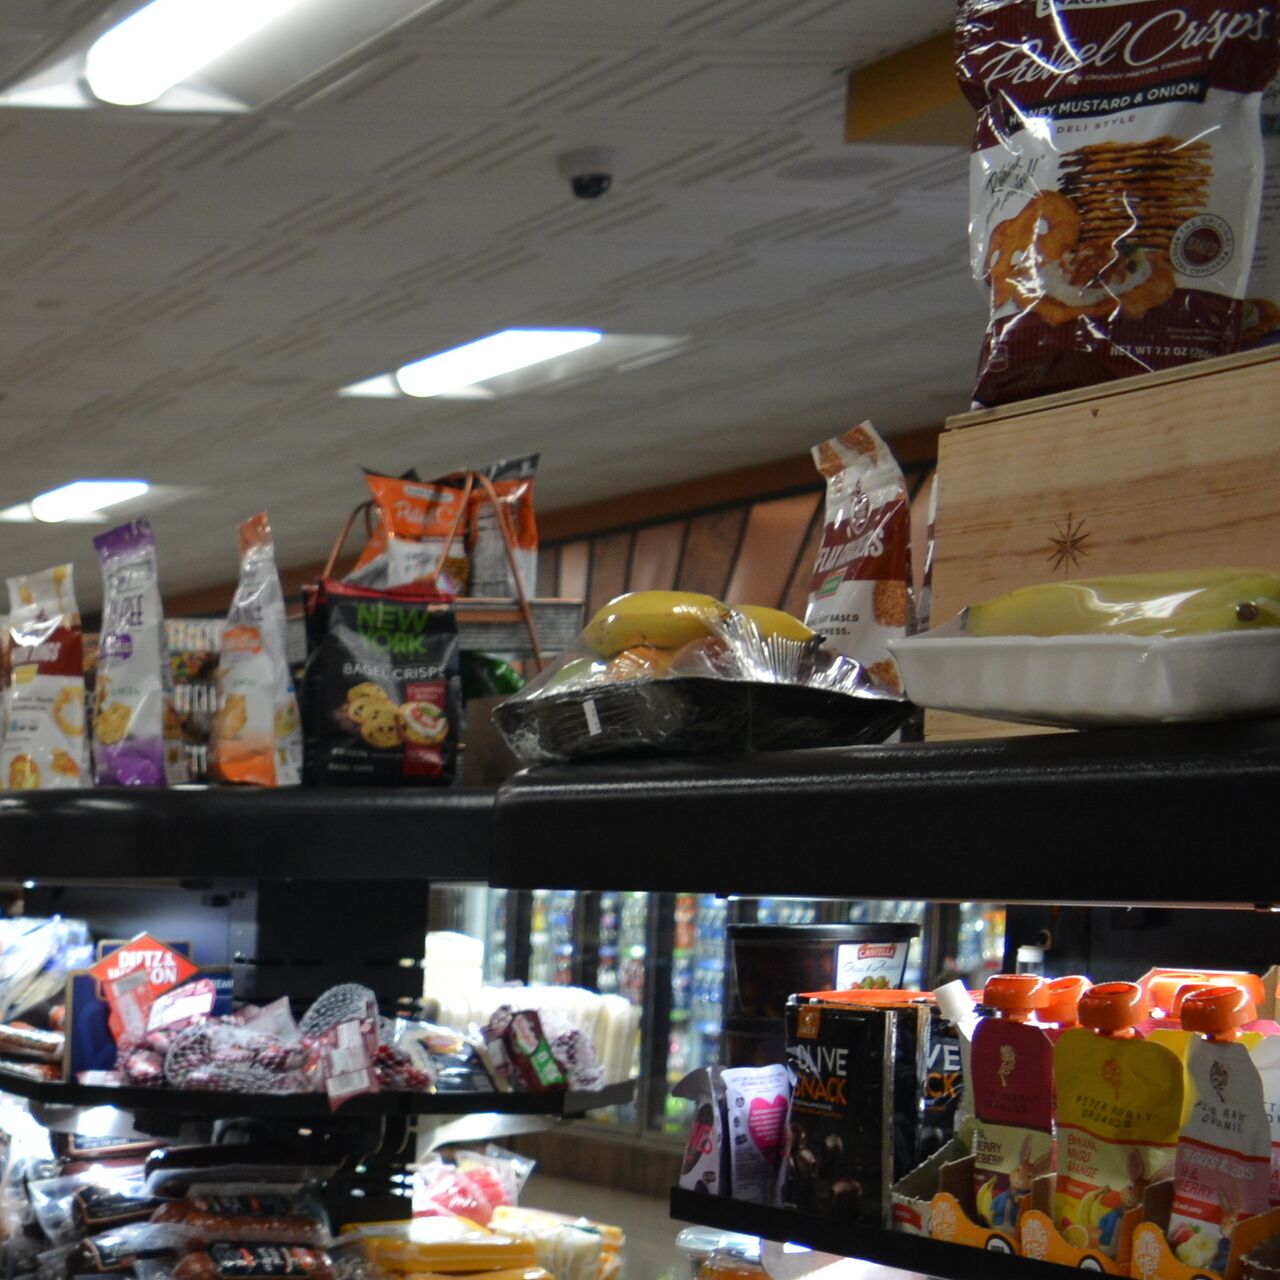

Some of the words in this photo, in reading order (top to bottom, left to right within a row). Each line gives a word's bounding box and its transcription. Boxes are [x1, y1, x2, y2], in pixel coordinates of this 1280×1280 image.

[1124, 9, 1273, 66] Crisps
[1009, 105, 1056, 126] HONEY
[1059, 93, 1129, 114] MUSTARD
[1132, 92, 1145, 106] &
[1148, 82, 1200, 102] ONION
[1056, 123, 1089, 134] DELI
[1094, 115, 1137, 129] STYLE
[357, 603, 432, 632] NEW
[364, 628, 429, 654] YORK
[342, 662, 389, 678] BAGEL
